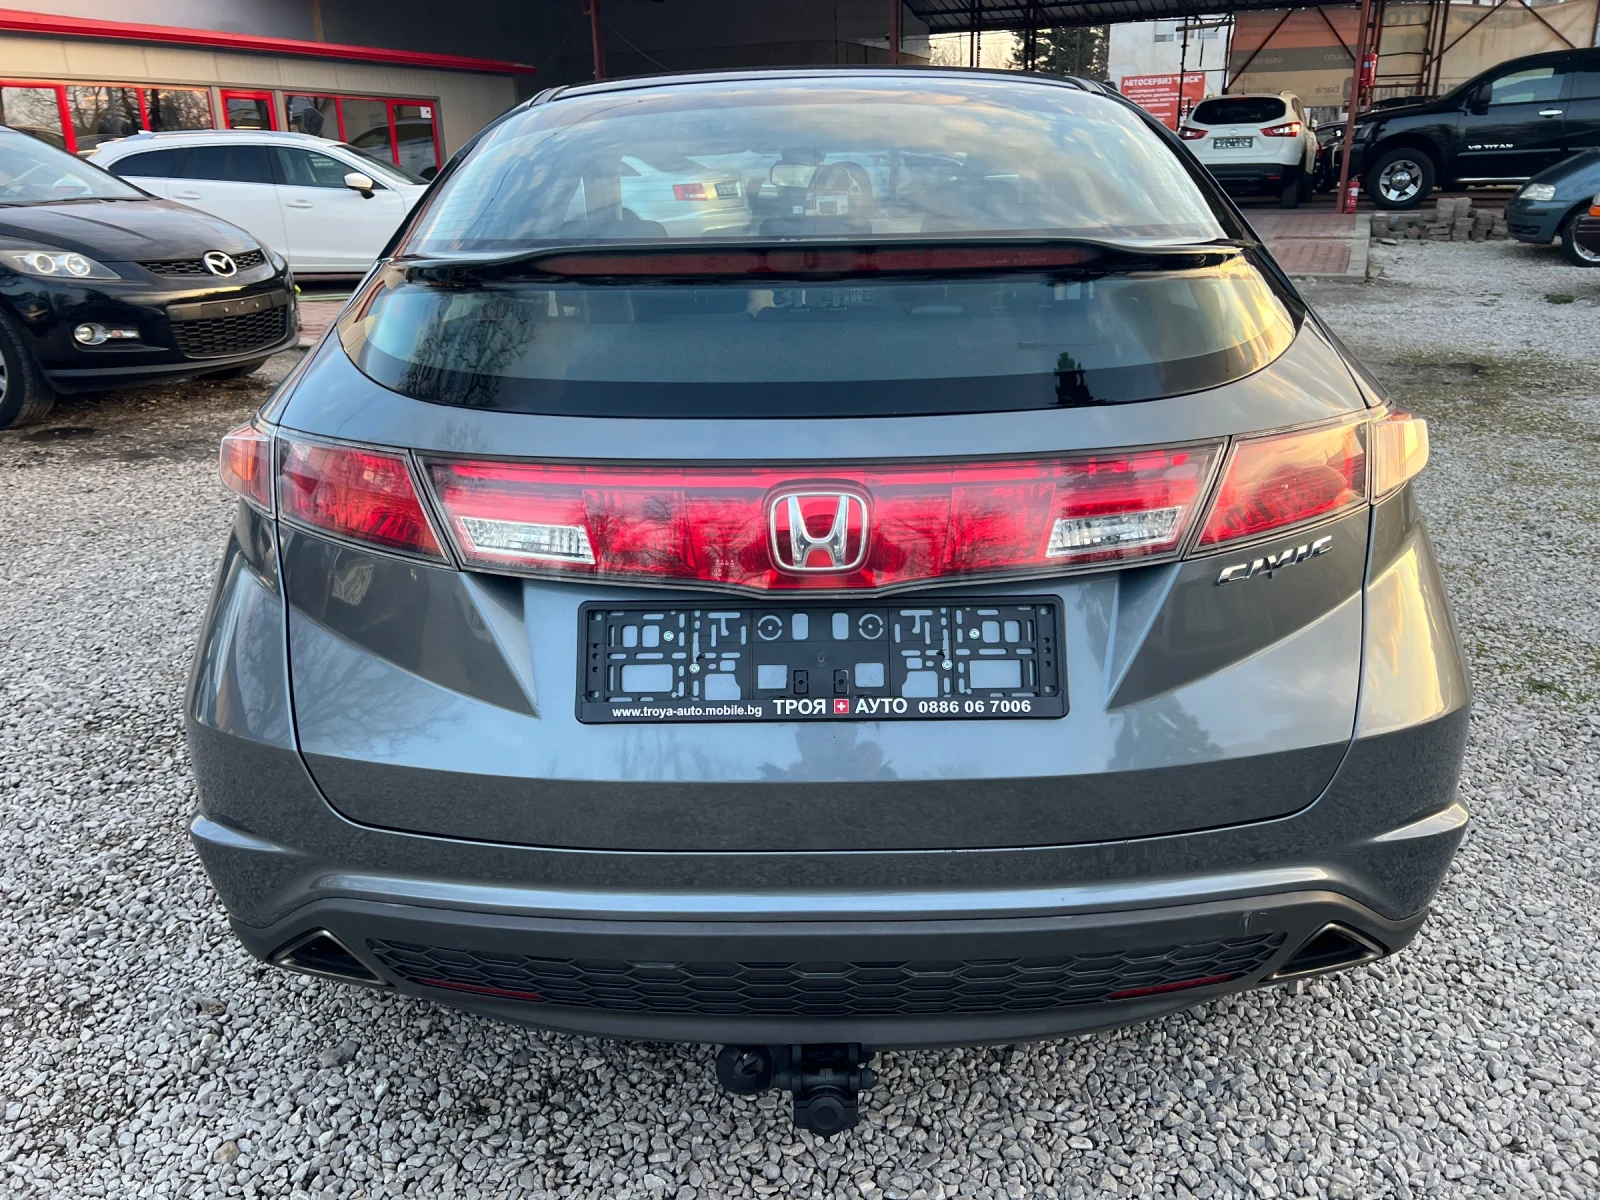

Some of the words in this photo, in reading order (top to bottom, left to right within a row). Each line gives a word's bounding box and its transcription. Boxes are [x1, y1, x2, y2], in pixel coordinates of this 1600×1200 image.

[1123, 77, 1173, 87] АВТОСЕРВИЗ
[1215, 535, 1333, 585] CIVIC
[612, 704, 762, 719] www.troya-auto.mobile.bg
[772, 698, 826, 715] ТРОЯ
[855, 698, 908, 714] АУТО
[918, 700, 959, 714] 0886
[964, 700, 985, 713] 06
[989, 699, 1032, 713] 7006
